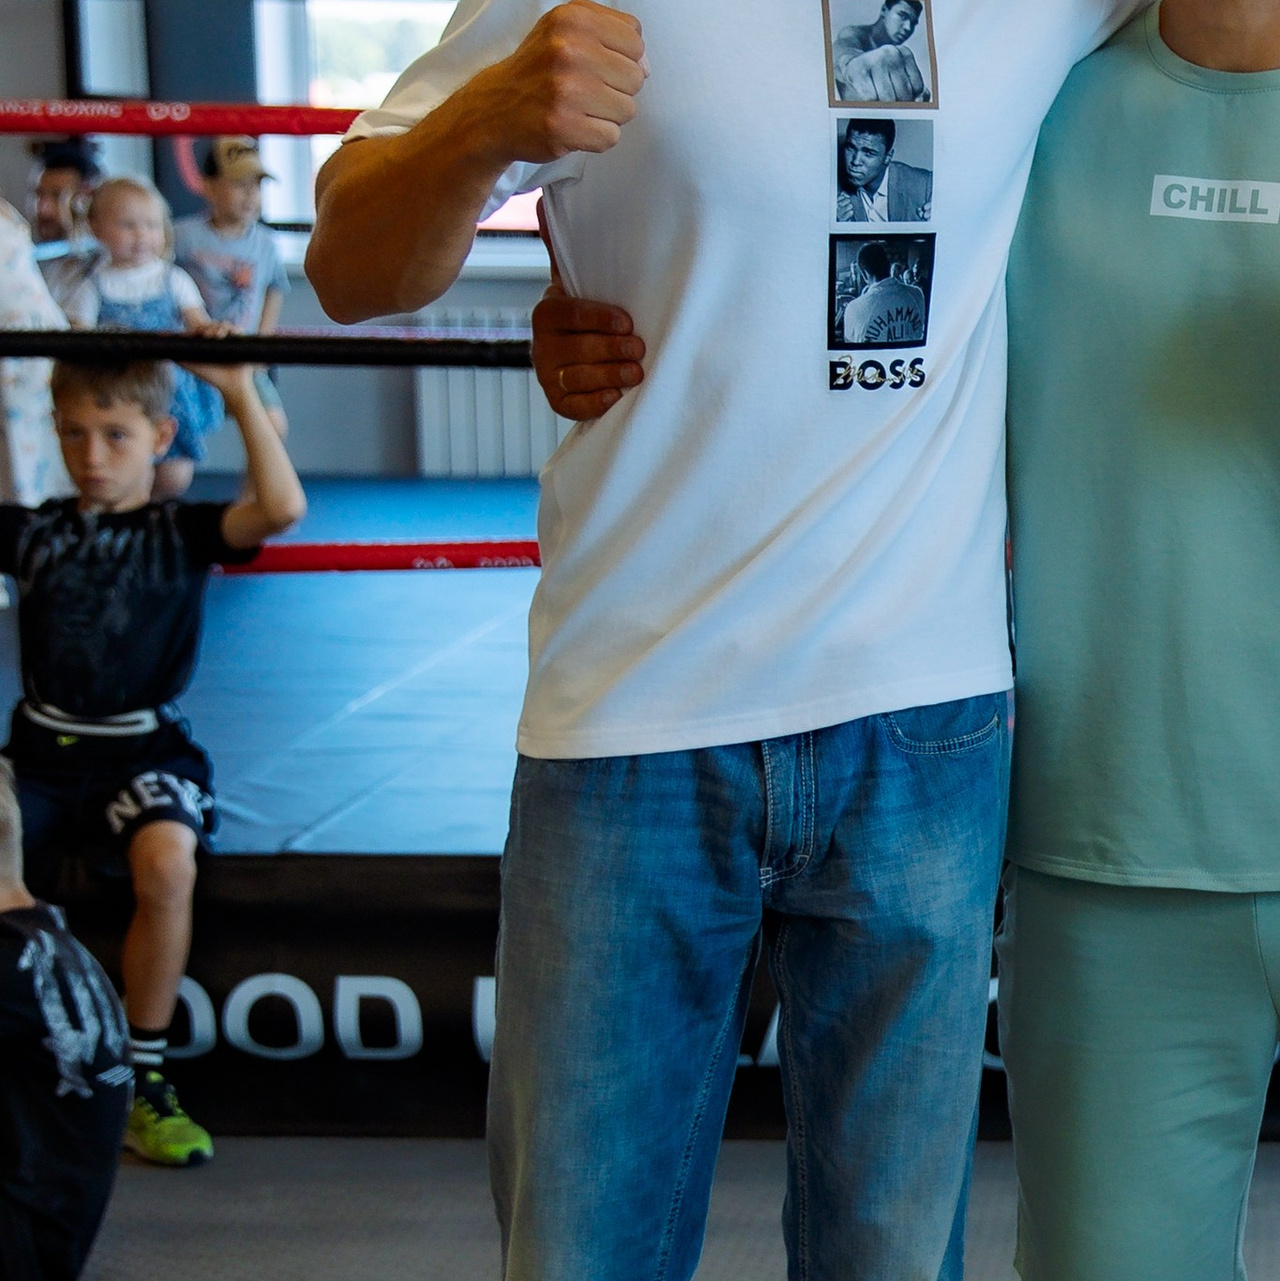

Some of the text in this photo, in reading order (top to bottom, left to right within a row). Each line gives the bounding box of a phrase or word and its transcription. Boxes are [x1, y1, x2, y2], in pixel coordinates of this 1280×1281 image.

[1163, 183, 1269, 215] CHILL
[886, 324, 904, 342] ALI
[829, 357, 926, 391] BOSS
[163, 973, 424, 1060] OOD
